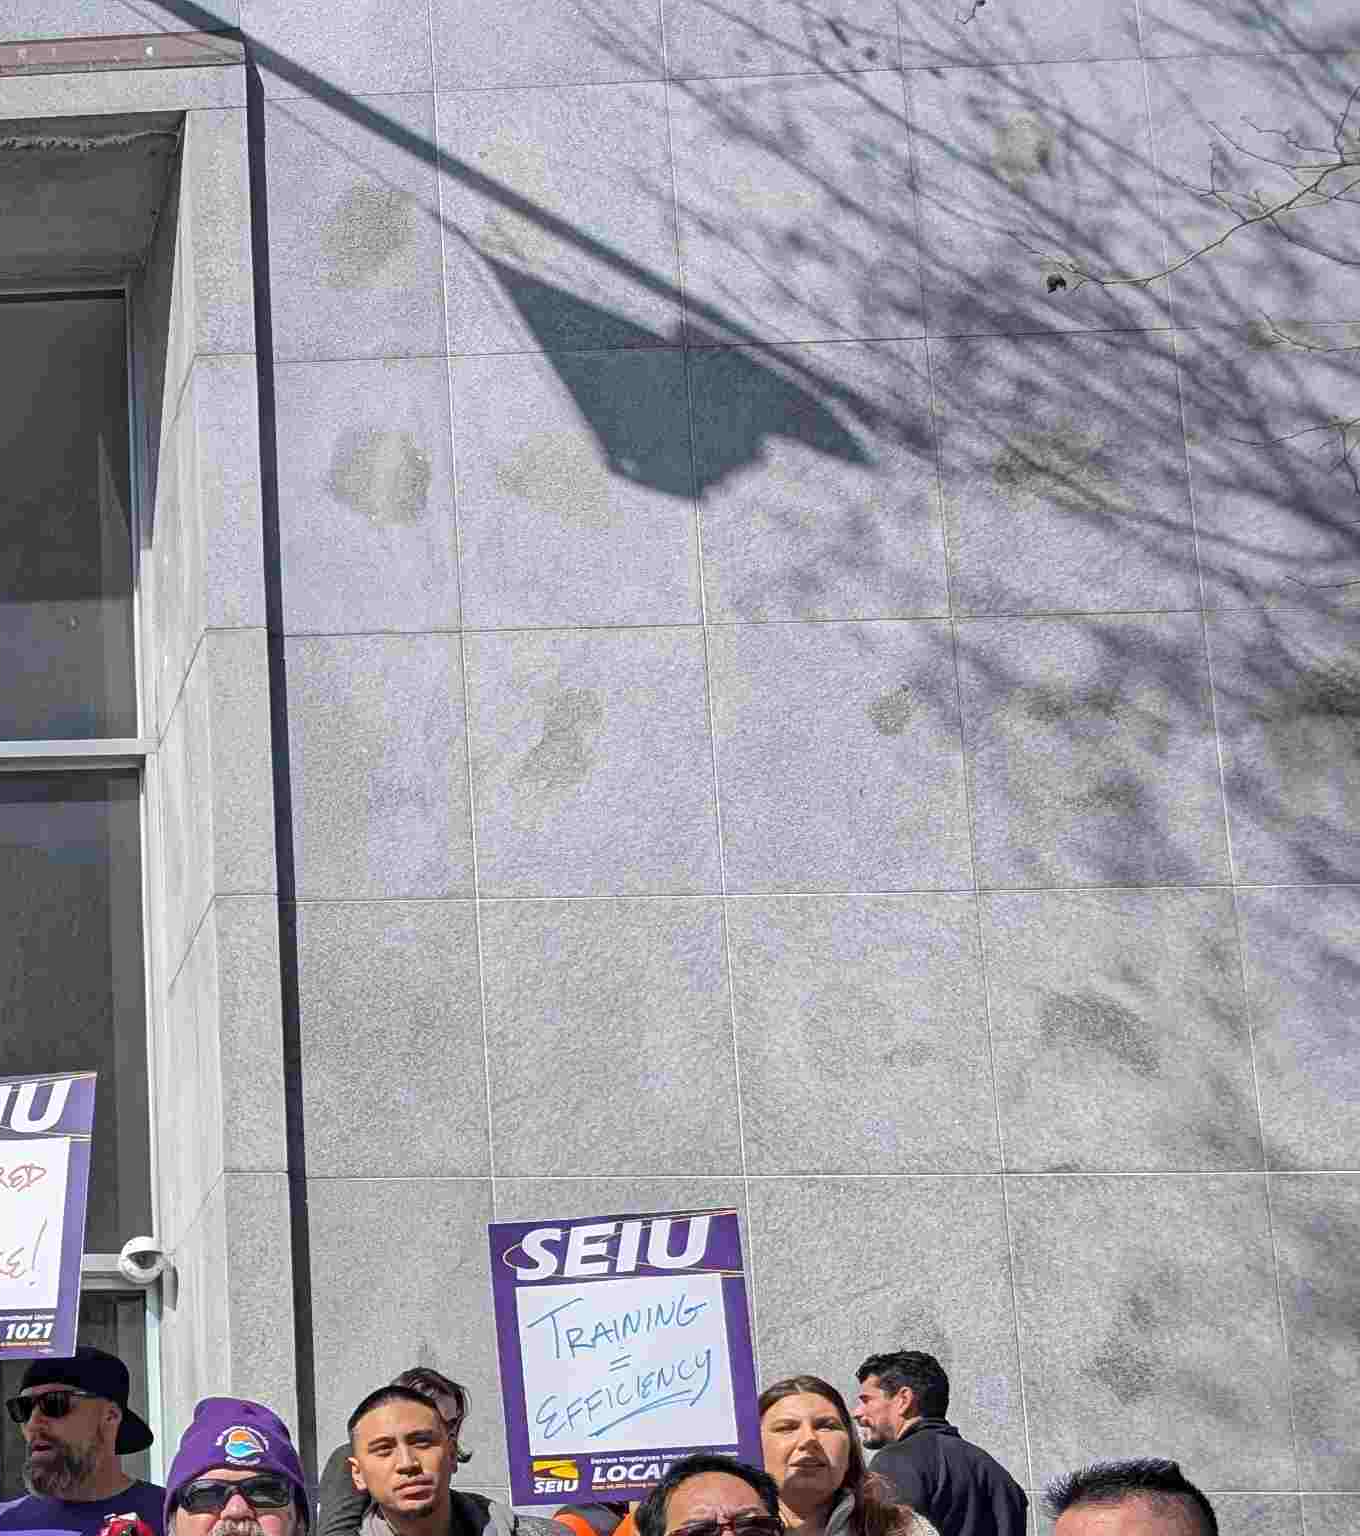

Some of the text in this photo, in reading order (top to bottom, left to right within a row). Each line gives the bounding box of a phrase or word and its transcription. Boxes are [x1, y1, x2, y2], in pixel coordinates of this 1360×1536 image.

[516, 1215, 711, 1282] SEIU
[5, 1322, 54, 1341] 1021
[527, 1294, 708, 1360] TRAINING
[536, 1348, 712, 1440] EFFICIENCY
[533, 1480, 579, 1494] SEIU
